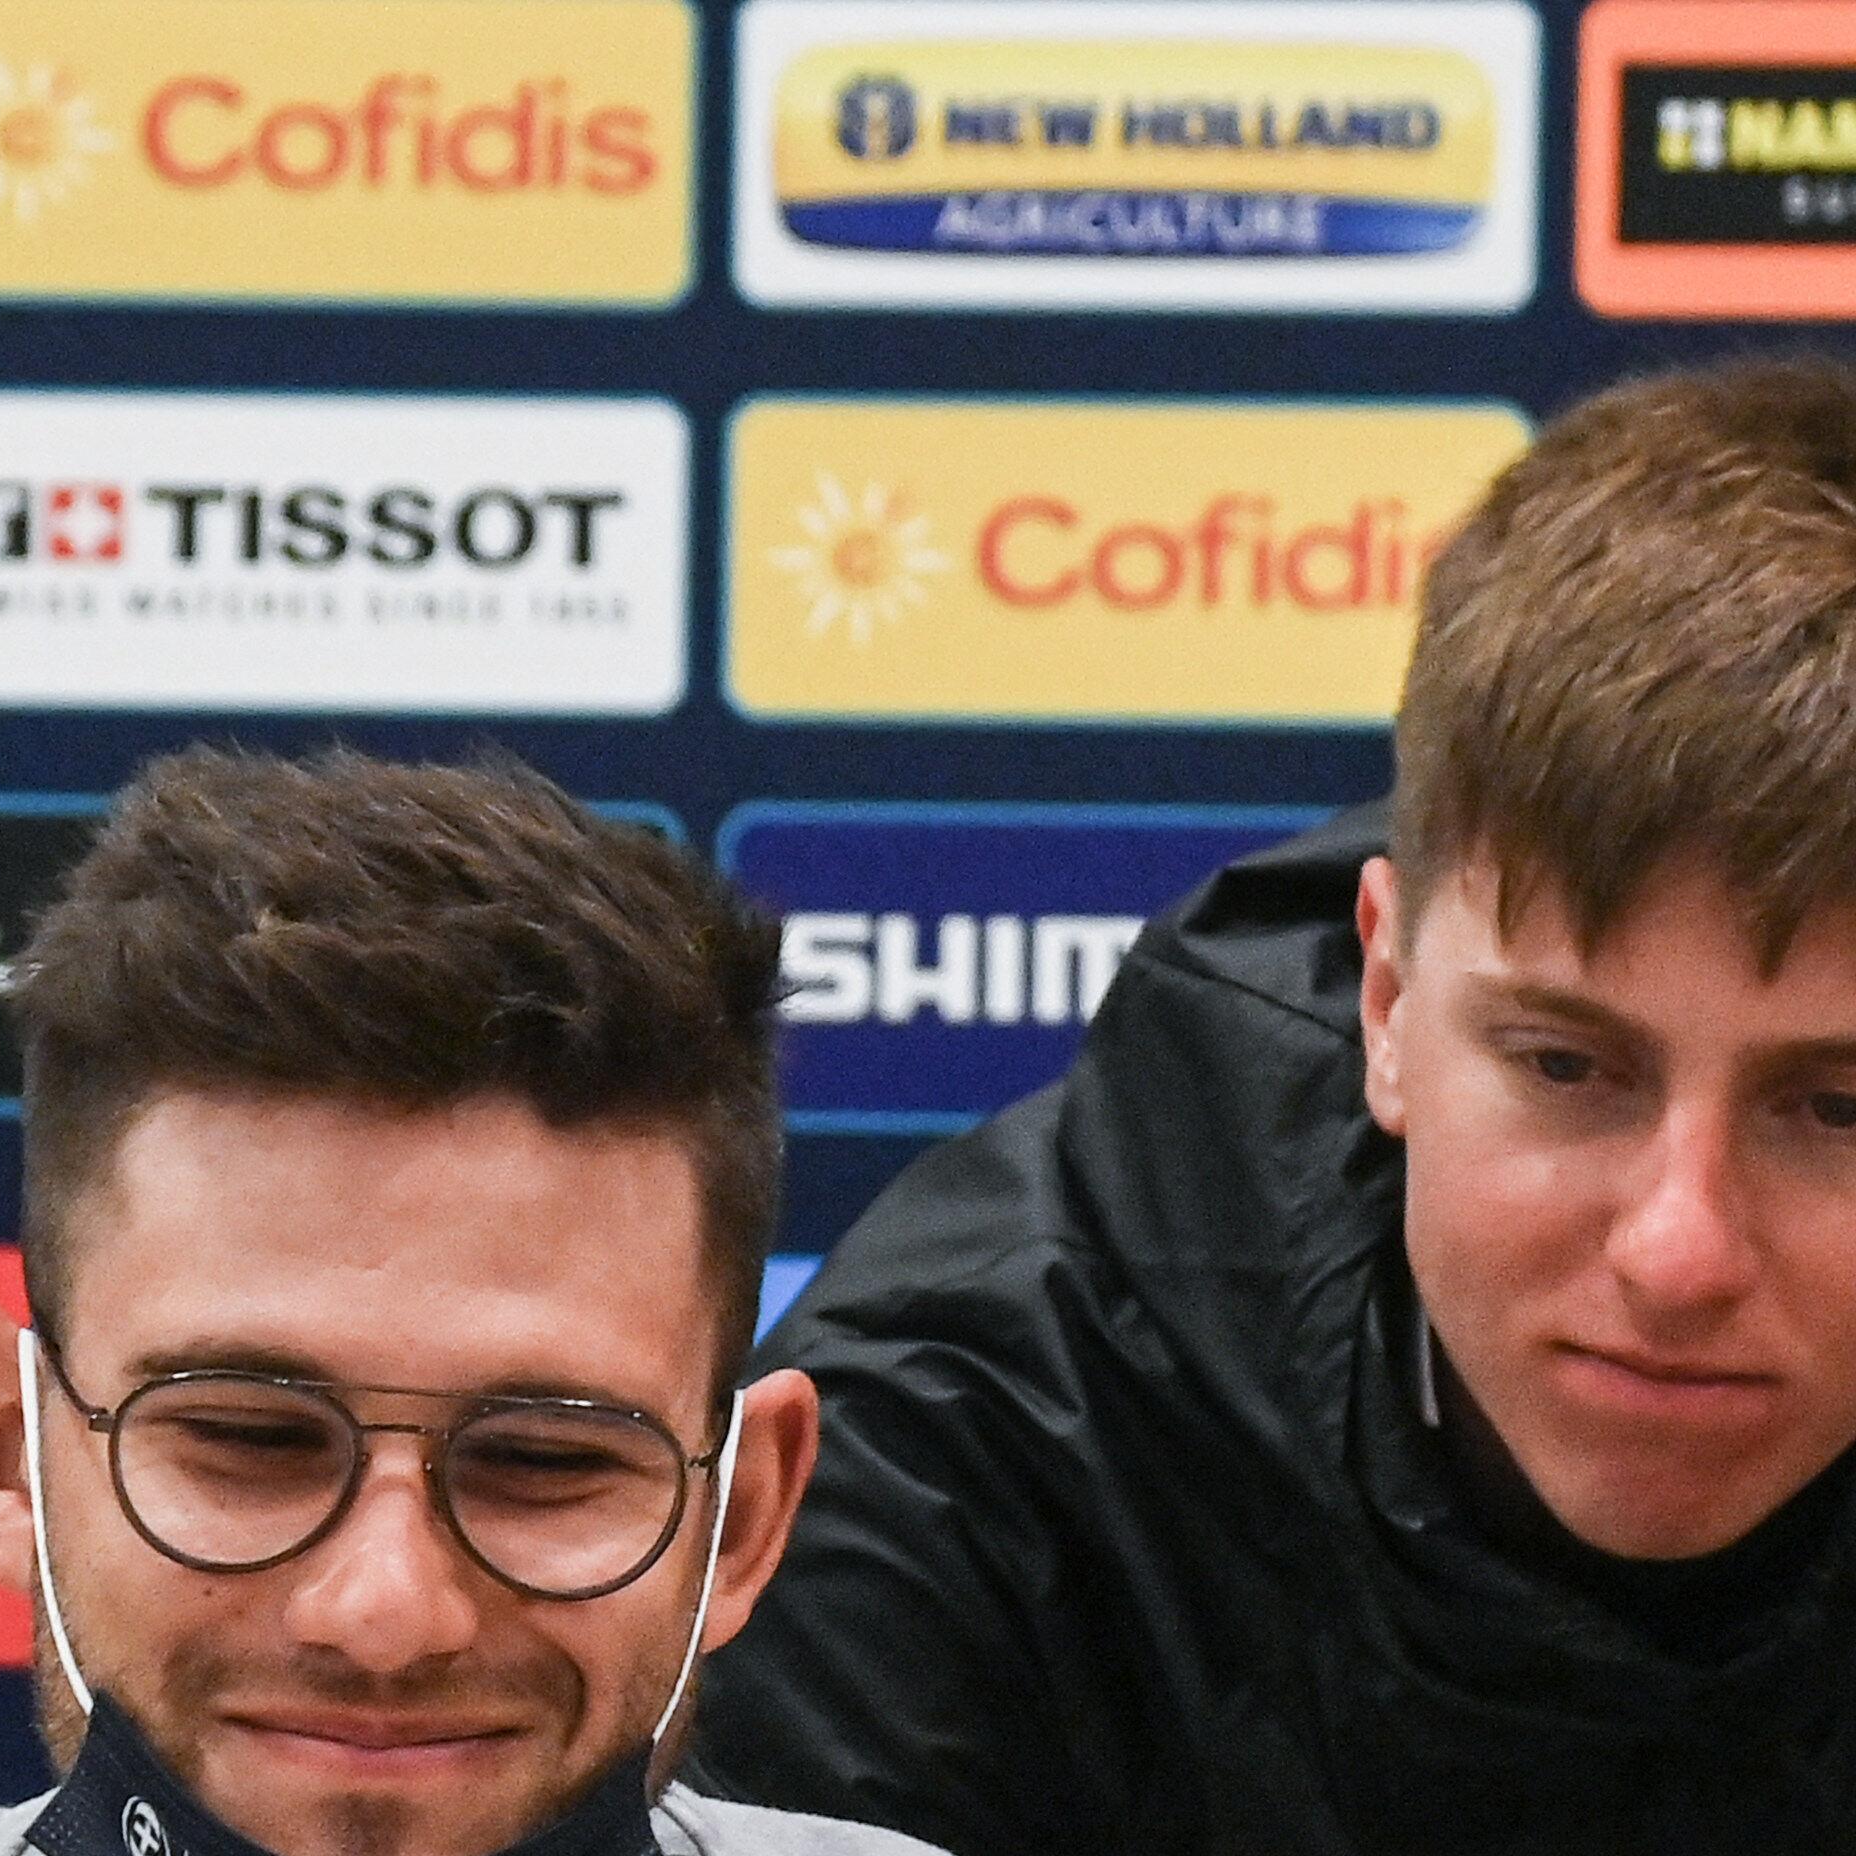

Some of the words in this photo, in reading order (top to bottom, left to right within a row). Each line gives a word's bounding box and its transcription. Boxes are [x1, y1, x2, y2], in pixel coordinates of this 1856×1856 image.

[137, 73, 659, 199] Cofidis
[941, 103, 1097, 152] NEW
[1118, 102, 1441, 157] HOLLAND
[147, 487, 622, 569] TISSOT
